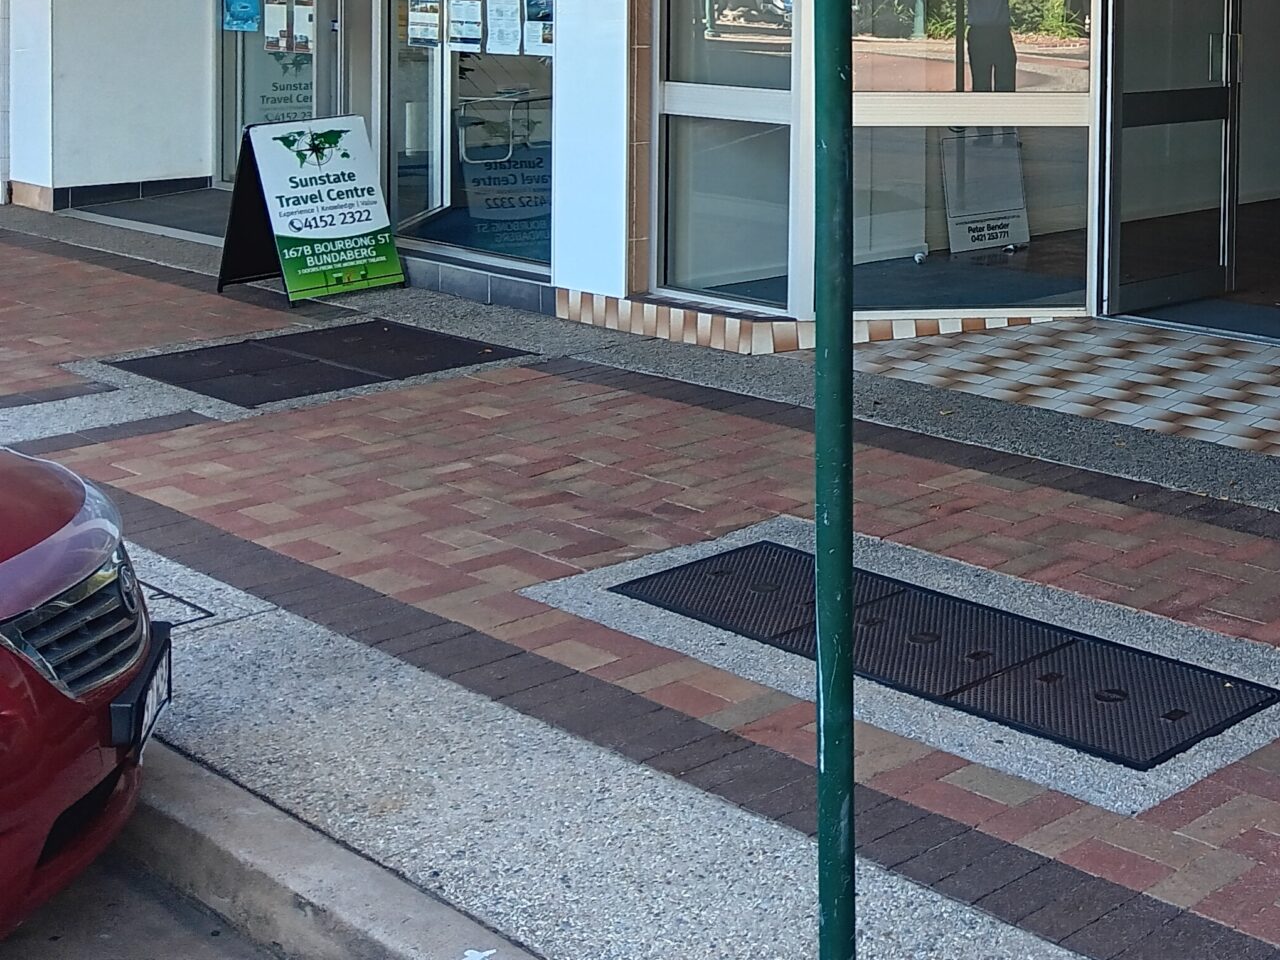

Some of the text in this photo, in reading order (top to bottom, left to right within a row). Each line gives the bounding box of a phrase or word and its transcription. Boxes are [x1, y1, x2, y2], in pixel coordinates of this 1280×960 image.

[271, 81, 313, 92] Sunstat
[260, 94, 293, 105] Travel
[288, 170, 356, 189] Sunstate
[275, 186, 376, 208] Travel Centre
[303, 209, 373, 230] 4152 2322
[968, 225, 986, 233] Peter
[282, 233, 392, 259] 167B BOURBONG ST
[306, 246, 377, 267] BUNDABERG
